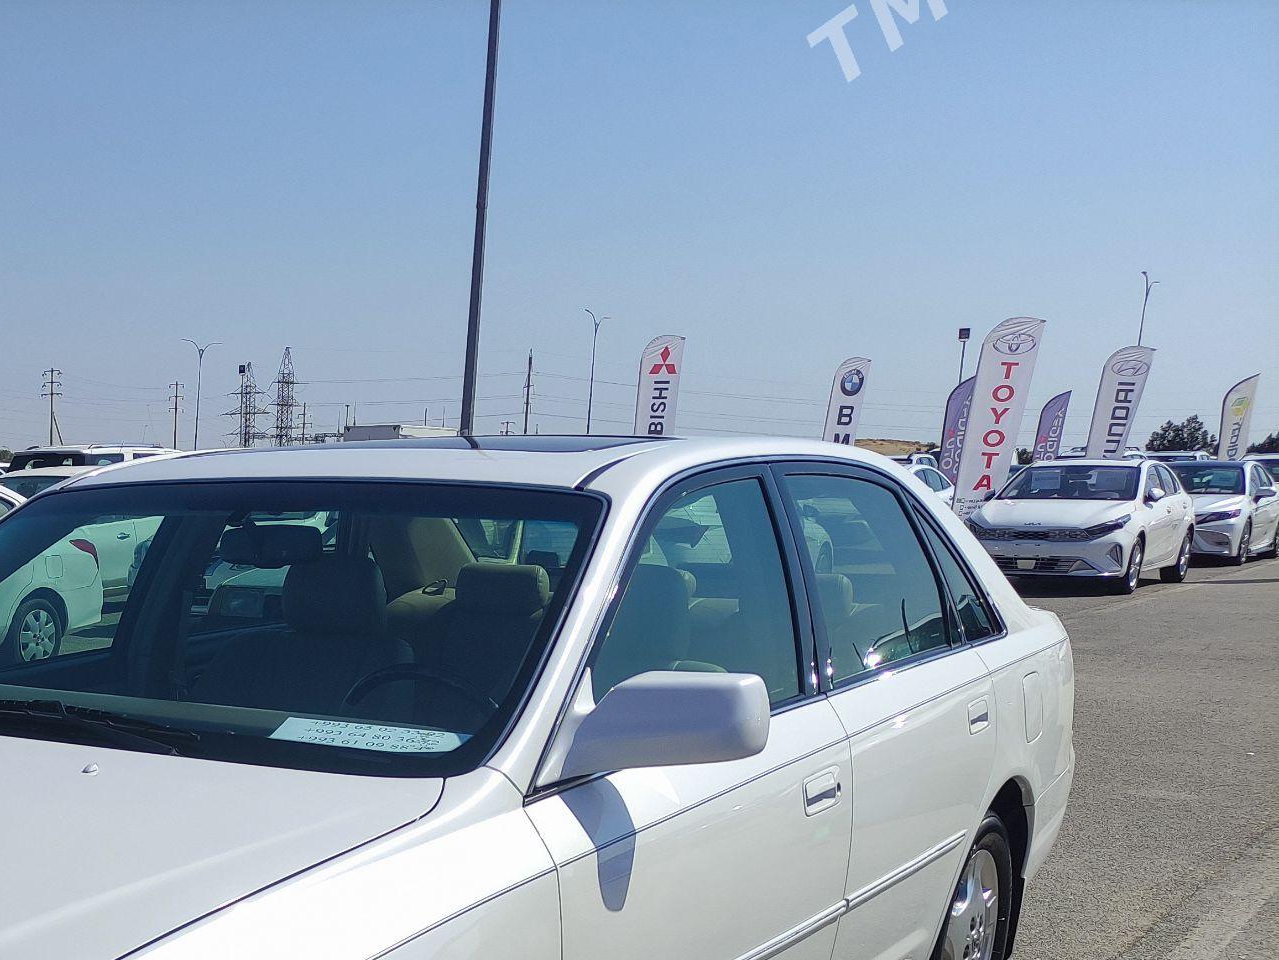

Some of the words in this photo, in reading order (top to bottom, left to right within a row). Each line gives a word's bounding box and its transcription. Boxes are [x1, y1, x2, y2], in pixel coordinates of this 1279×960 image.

[647, 380, 671, 435] BISHI
[973, 361, 1020, 491] TOYOTA
[1102, 381, 1136, 459] UNDAI
